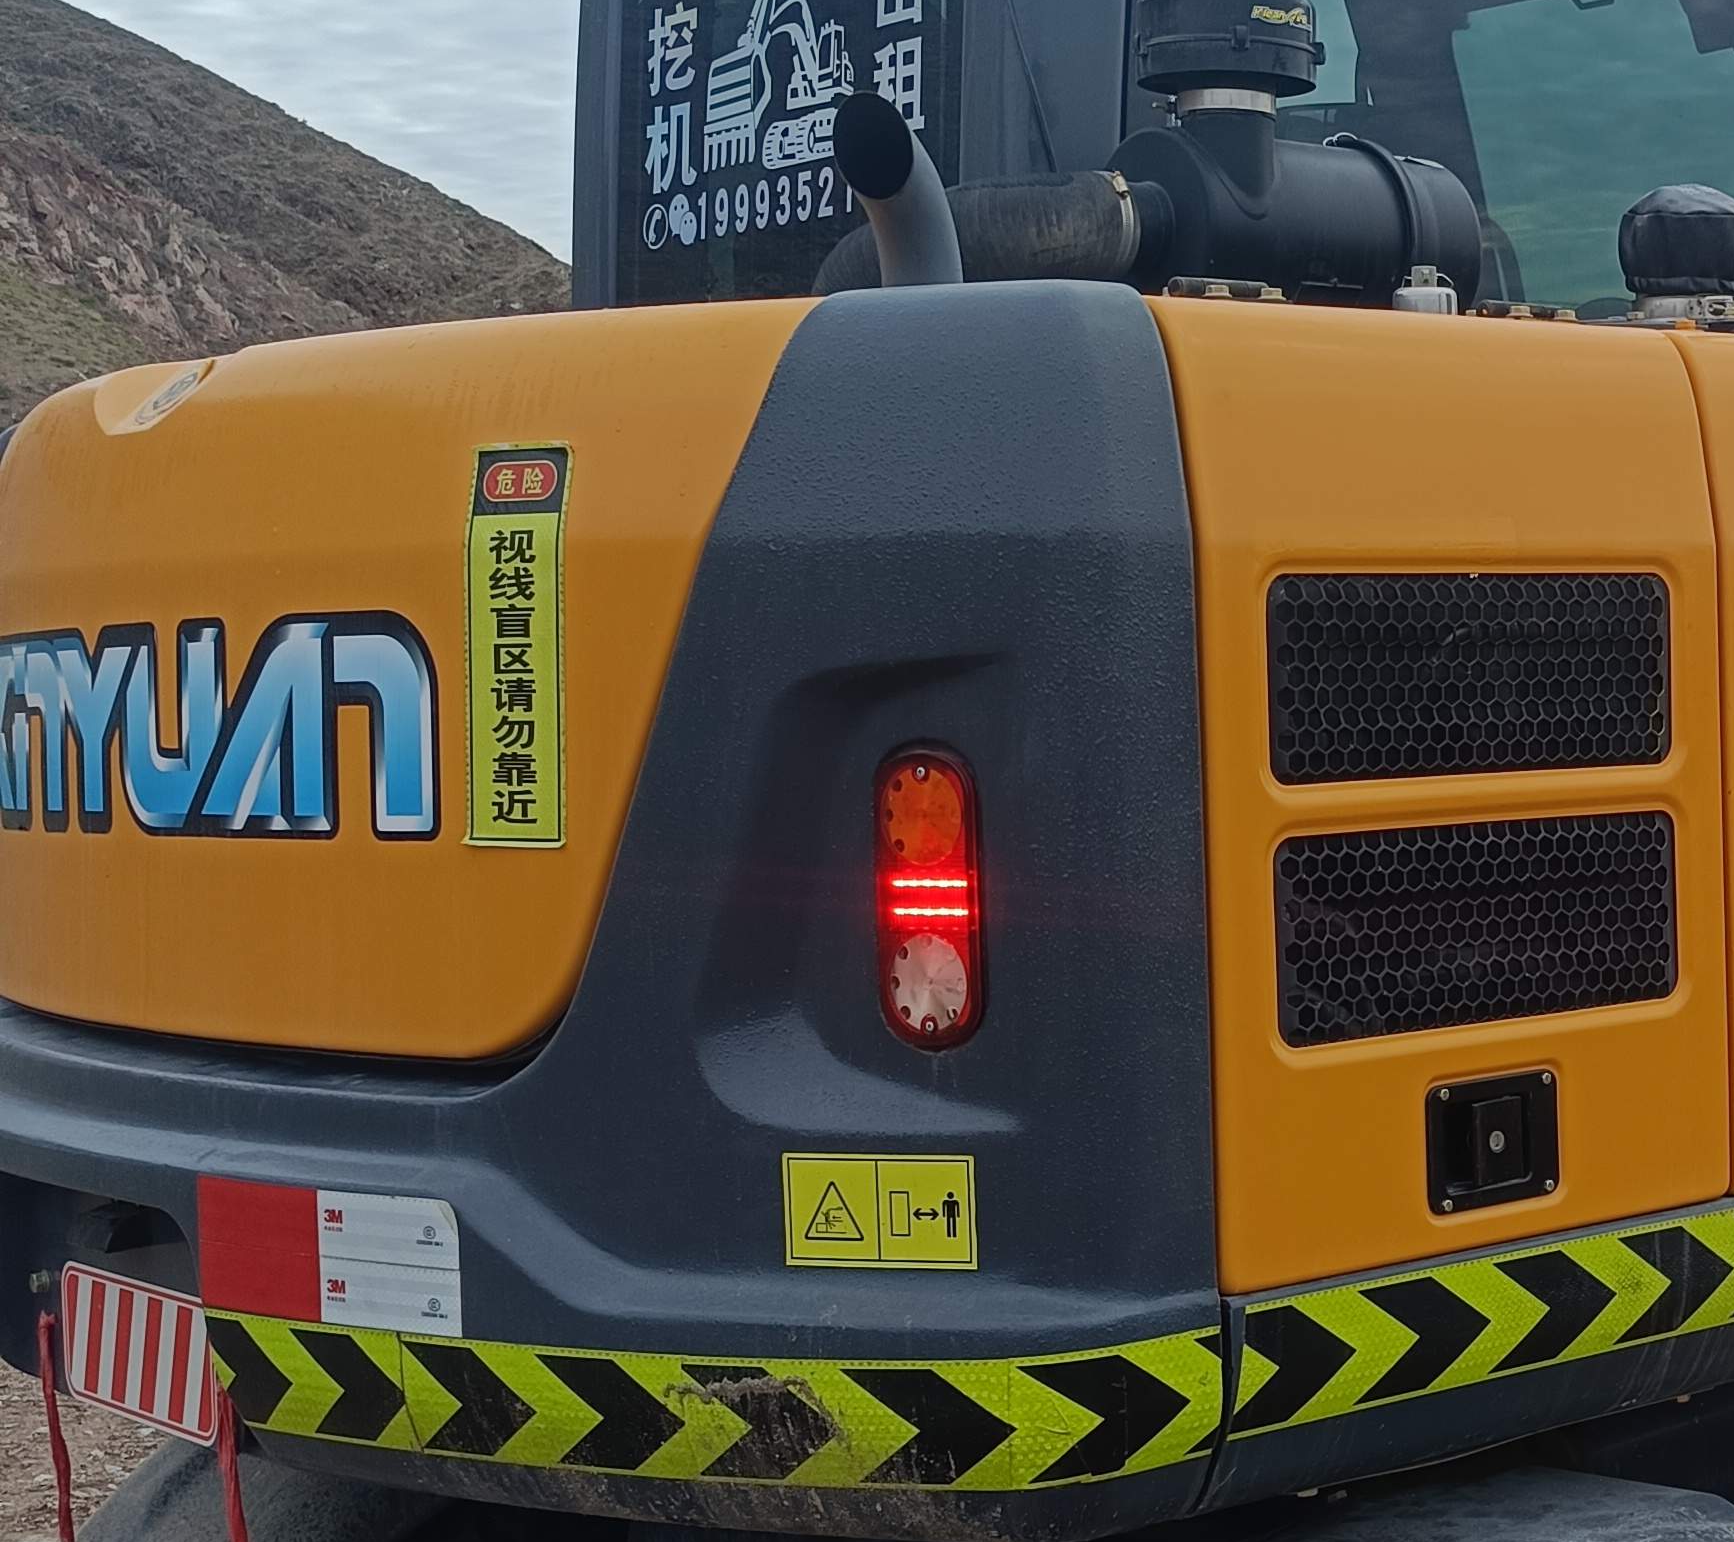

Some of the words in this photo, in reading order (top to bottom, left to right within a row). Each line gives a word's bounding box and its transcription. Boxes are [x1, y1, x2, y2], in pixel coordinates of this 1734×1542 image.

[645, 2, 698, 194] 挖机
[495, 467, 545, 496] 危险
[488, 529, 538, 825] 视线盲区请勿靠近
[323, 1208, 343, 1225] 3M
[326, 1278, 346, 1295] 3M
